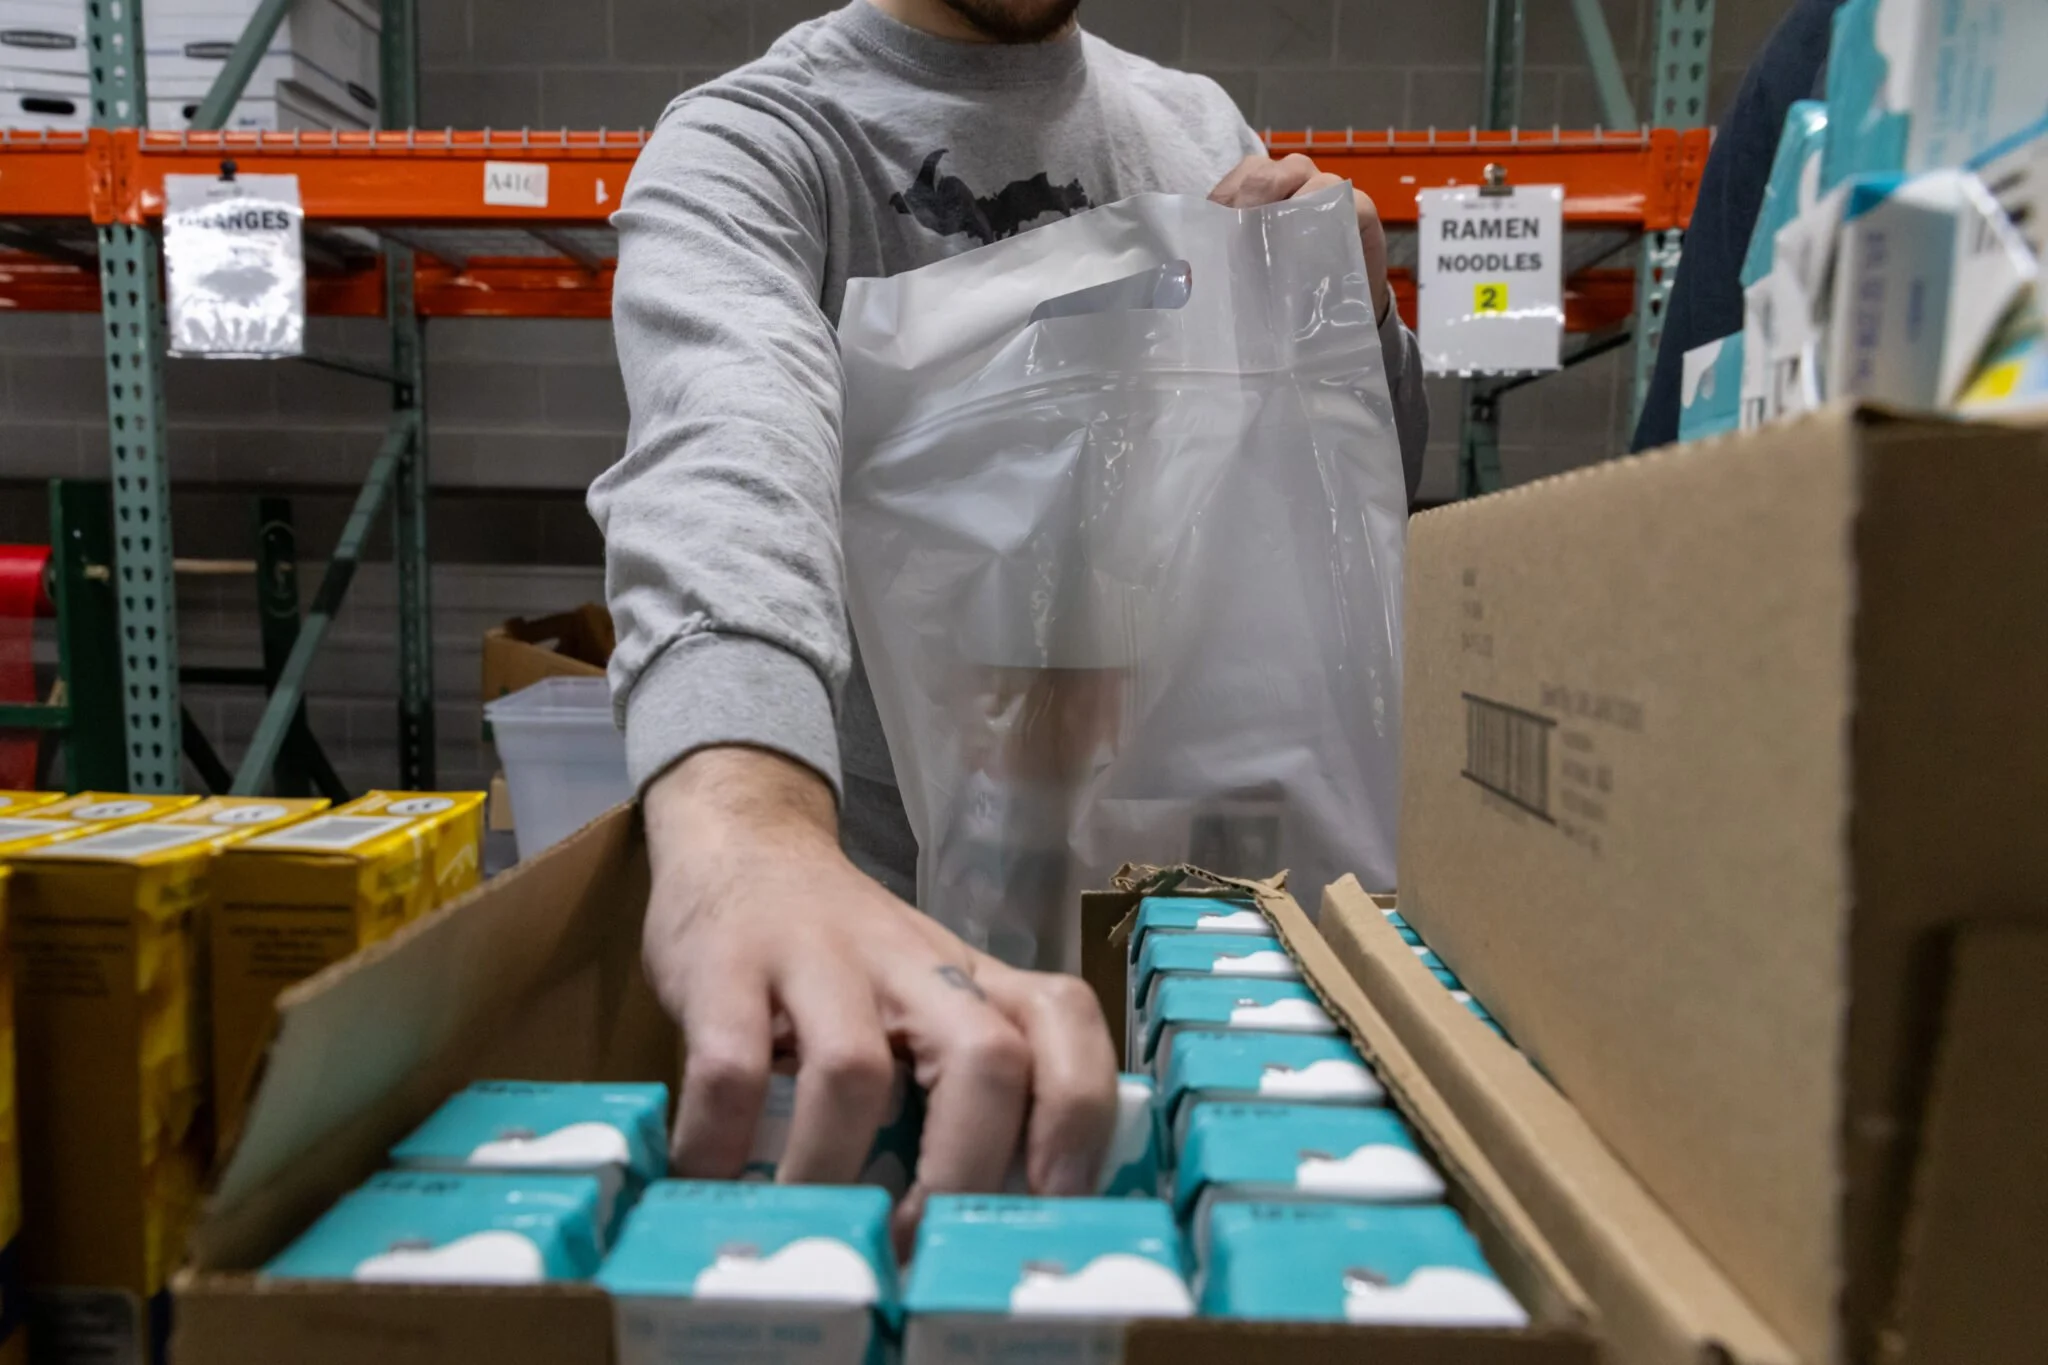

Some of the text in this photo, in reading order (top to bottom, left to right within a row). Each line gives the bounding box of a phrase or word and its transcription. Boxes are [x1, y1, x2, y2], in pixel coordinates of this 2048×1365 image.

[179, 209, 291, 230] ANGES
[1441, 217, 1540, 240] RAMEN
[1437, 253, 1542, 274] NOODLES
[1480, 287, 1498, 309] 2
